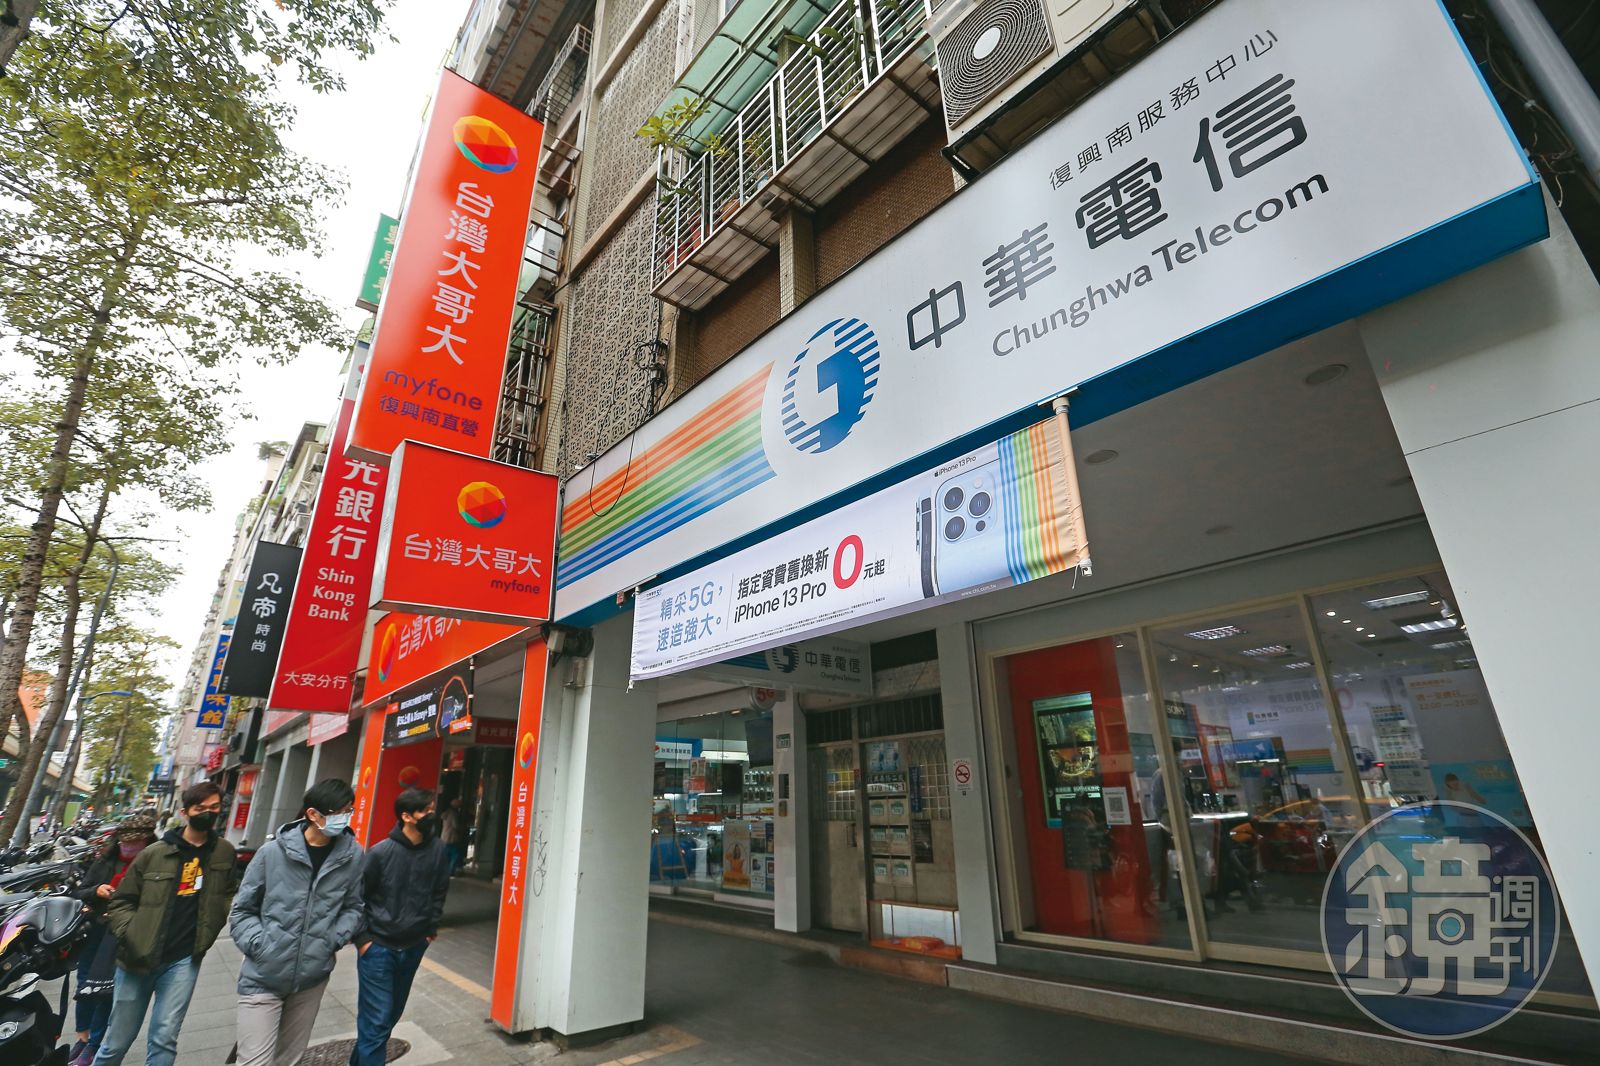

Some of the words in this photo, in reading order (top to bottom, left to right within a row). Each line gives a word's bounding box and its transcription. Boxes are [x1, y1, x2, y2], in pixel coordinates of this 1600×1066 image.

[1049, 29, 1279, 191] 復興南服務中心
[906, 73, 1308, 351] 中華電信
[421, 181, 496, 366] 台灣大哥大
[992, 264, 1153, 357] Chunghwa
[1151, 173, 1330, 274] Telecom
[384, 369, 483, 411] myfone
[379, 395, 479, 438] 復興南直營
[938, 463, 959, 477] iPhone
[965, 455, 977, 466] Pro
[317, 567, 355, 585] Shin
[404, 532, 542, 578] 台灣大哥大
[737, 547, 829, 600] 指定資費舊換新
[833, 534, 864, 590] 0
[863, 558, 886, 581] 元起
[312, 585, 355, 607] Kong
[490, 578, 541, 595] myfone
[734, 597, 780, 624] iPhone
[782, 587, 798, 609] 13
[800, 581, 827, 603] Pro
[308, 604, 350, 622] Bank
[283, 671, 348, 690] 大安分行
[805, 650, 861, 674] 中華電信
[508, 781, 528, 905] 台灣大哥大
